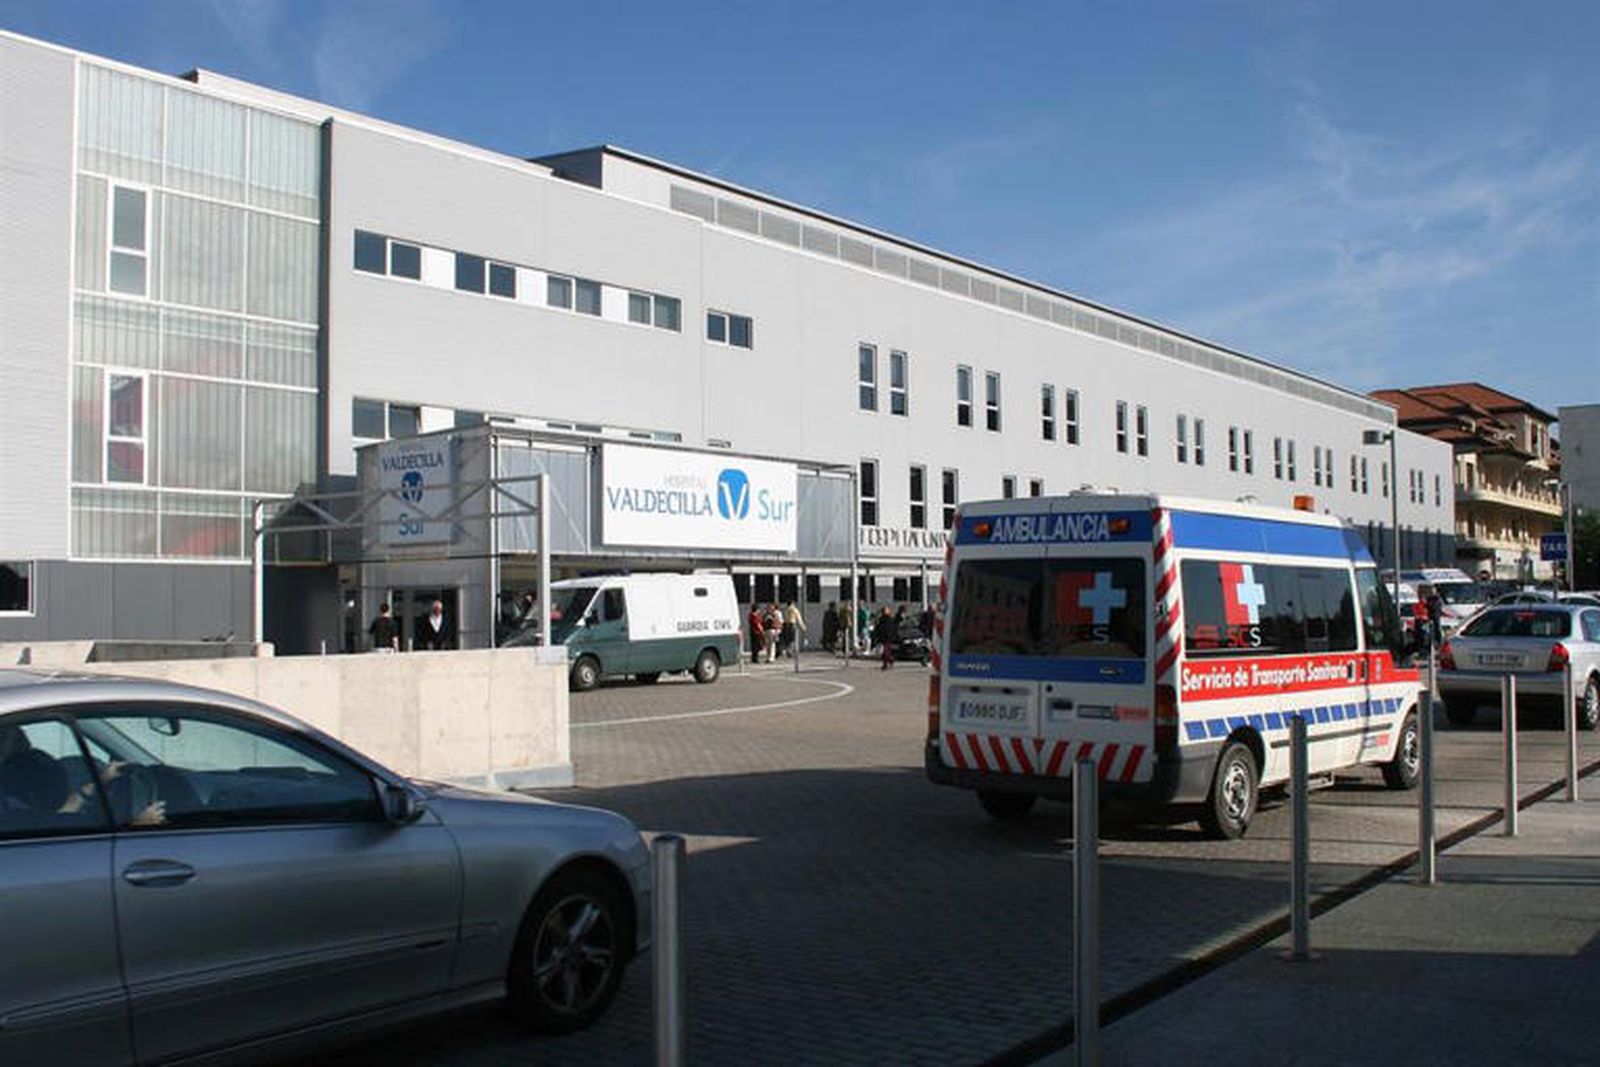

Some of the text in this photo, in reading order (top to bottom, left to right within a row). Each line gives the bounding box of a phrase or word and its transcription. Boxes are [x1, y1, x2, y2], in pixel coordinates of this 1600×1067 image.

[382, 452, 445, 472] VALDECILLA
[606, 486, 713, 516] VALDECILLA
[757, 489, 794, 522] Sur
[990, 513, 1110, 542] AMBULANCIA
[1182, 665, 1232, 693] Servicio
[1233, 664, 1249, 688] de
[1250, 663, 1305, 689] Transporte
